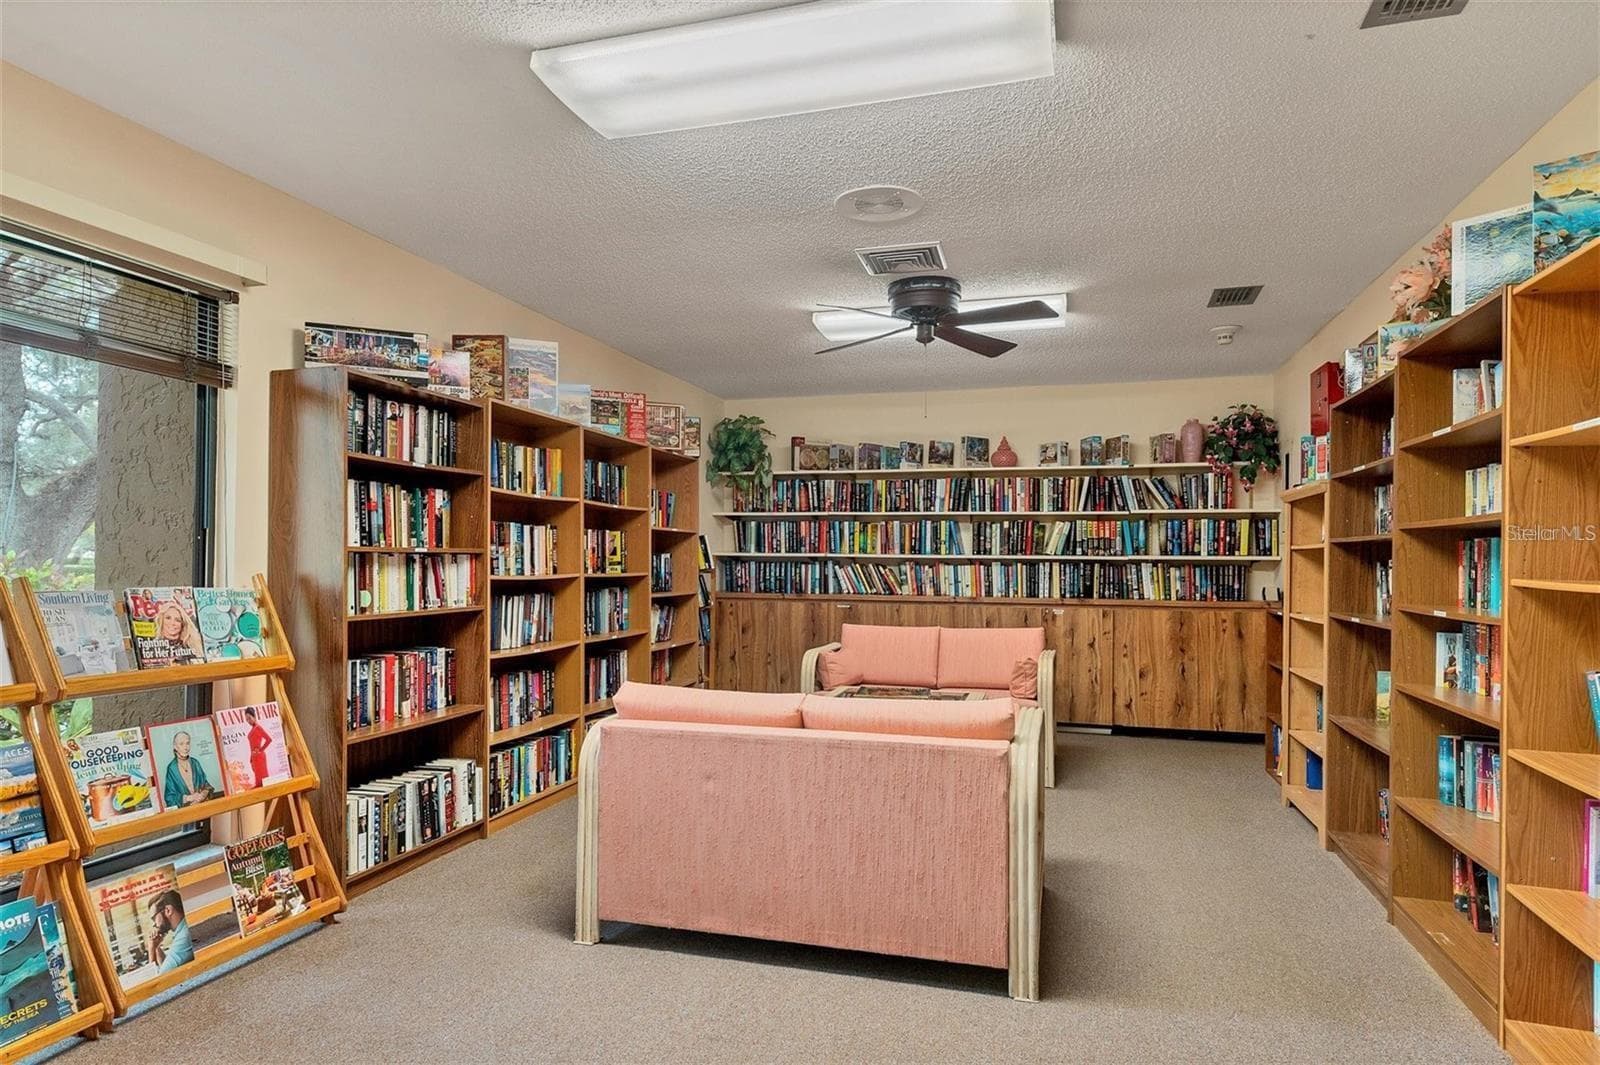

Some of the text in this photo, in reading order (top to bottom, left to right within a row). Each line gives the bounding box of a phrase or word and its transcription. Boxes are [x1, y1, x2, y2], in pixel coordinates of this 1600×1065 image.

[39, 592, 109, 605] Southern Living
[138, 639, 169, 651] Fighting
[143, 647, 155, 658] for
[155, 646, 169, 658] Her
[255, 703, 279, 720] FAIR
[86, 745, 119, 758] GOOD
[71, 749, 144, 769] OUSEKEEPING
[75, 768, 97, 780] lean
[227, 831, 286, 861] COTTAGES
[231, 855, 262, 872] Autumn
[0, 998, 48, 1025] ECRETS
[27, 1010, 40, 1021] SEA
